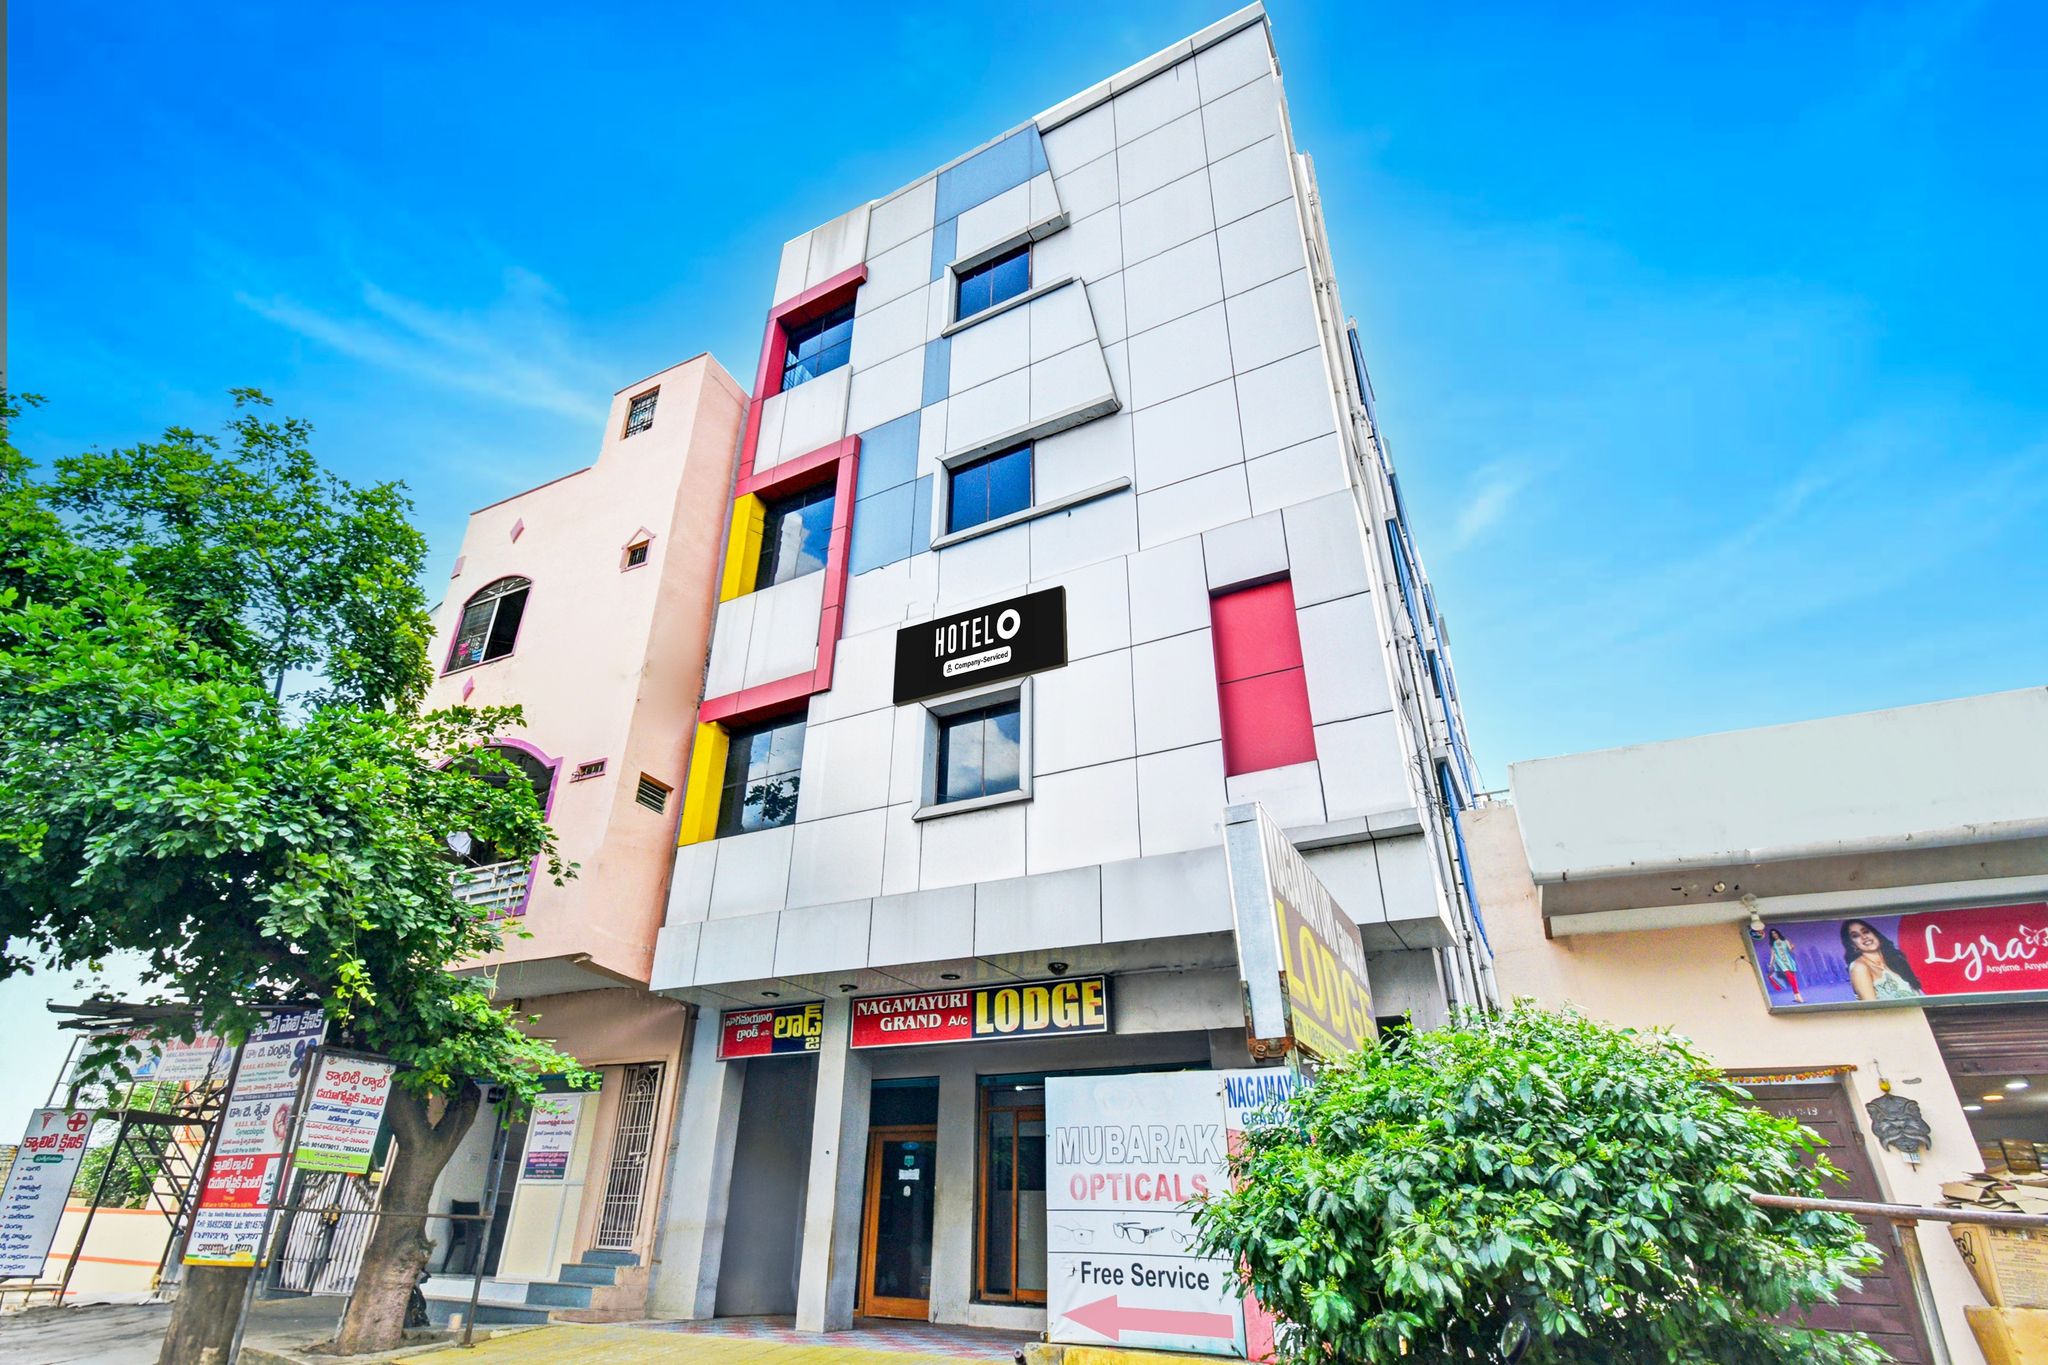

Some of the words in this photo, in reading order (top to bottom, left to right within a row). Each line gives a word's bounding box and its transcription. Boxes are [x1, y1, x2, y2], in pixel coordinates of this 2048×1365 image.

[935, 614, 994, 658] HOTEL
[954, 650, 1009, 670] Company-Serviced
[1924, 924, 2037, 982] Lyra
[2024, 960, 2048, 971] Anyw
[1275, 897, 1377, 1050] LODGE
[857, 992, 968, 1016] NAGAMAYURI
[975, 980, 1104, 1034] LODGE
[880, 1013, 942, 1032] GRAND
[947, 1015, 968, 1027] A/c
[1055, 1124, 1222, 1165] MUBARAK
[1069, 1172, 1209, 1203] OPTICALS
[1080, 1260, 1124, 1286] Free
[1131, 1261, 1210, 1291] Service
